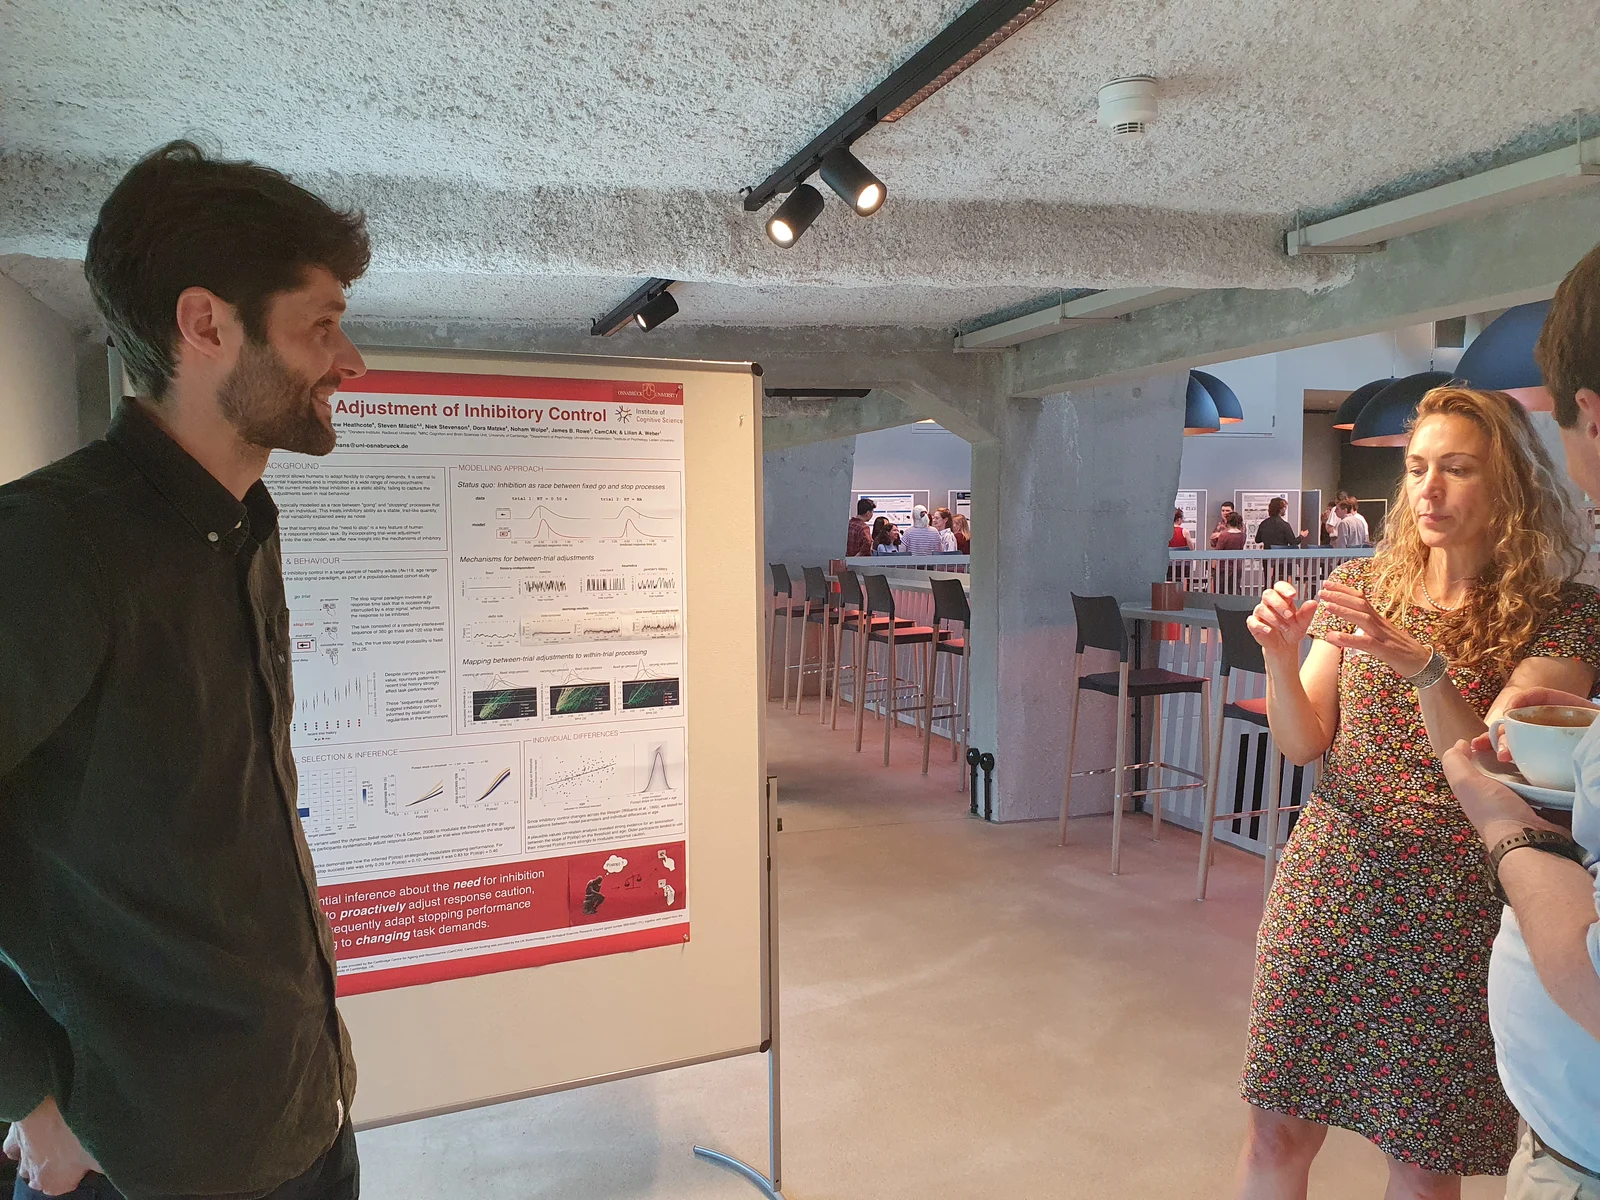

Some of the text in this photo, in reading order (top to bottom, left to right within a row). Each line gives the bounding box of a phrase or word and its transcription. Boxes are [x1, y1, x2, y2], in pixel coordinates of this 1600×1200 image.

[335, 400, 607, 423] Adjustment of Inhibitory Control
[636, 416, 660, 424] Cognitive
[533, 730, 618, 743] INDIVIDUAL DIFFERENCES
[302, 754, 345, 763] SELECTION
[355, 749, 398, 758] INFERENCE
[345, 889, 396, 903] inference
[399, 884, 430, 897] about
[432, 882, 450, 892] the
[453, 877, 481, 890] need
[483, 876, 496, 886] for
[500, 869, 544, 884] inhibition
[325, 885, 535, 921] to proactively adjust response caution,
[384, 914, 416, 930] adapt
[418, 908, 463, 925] stopping
[466, 900, 531, 918] performance
[341, 920, 490, 948] to changing task demands.
